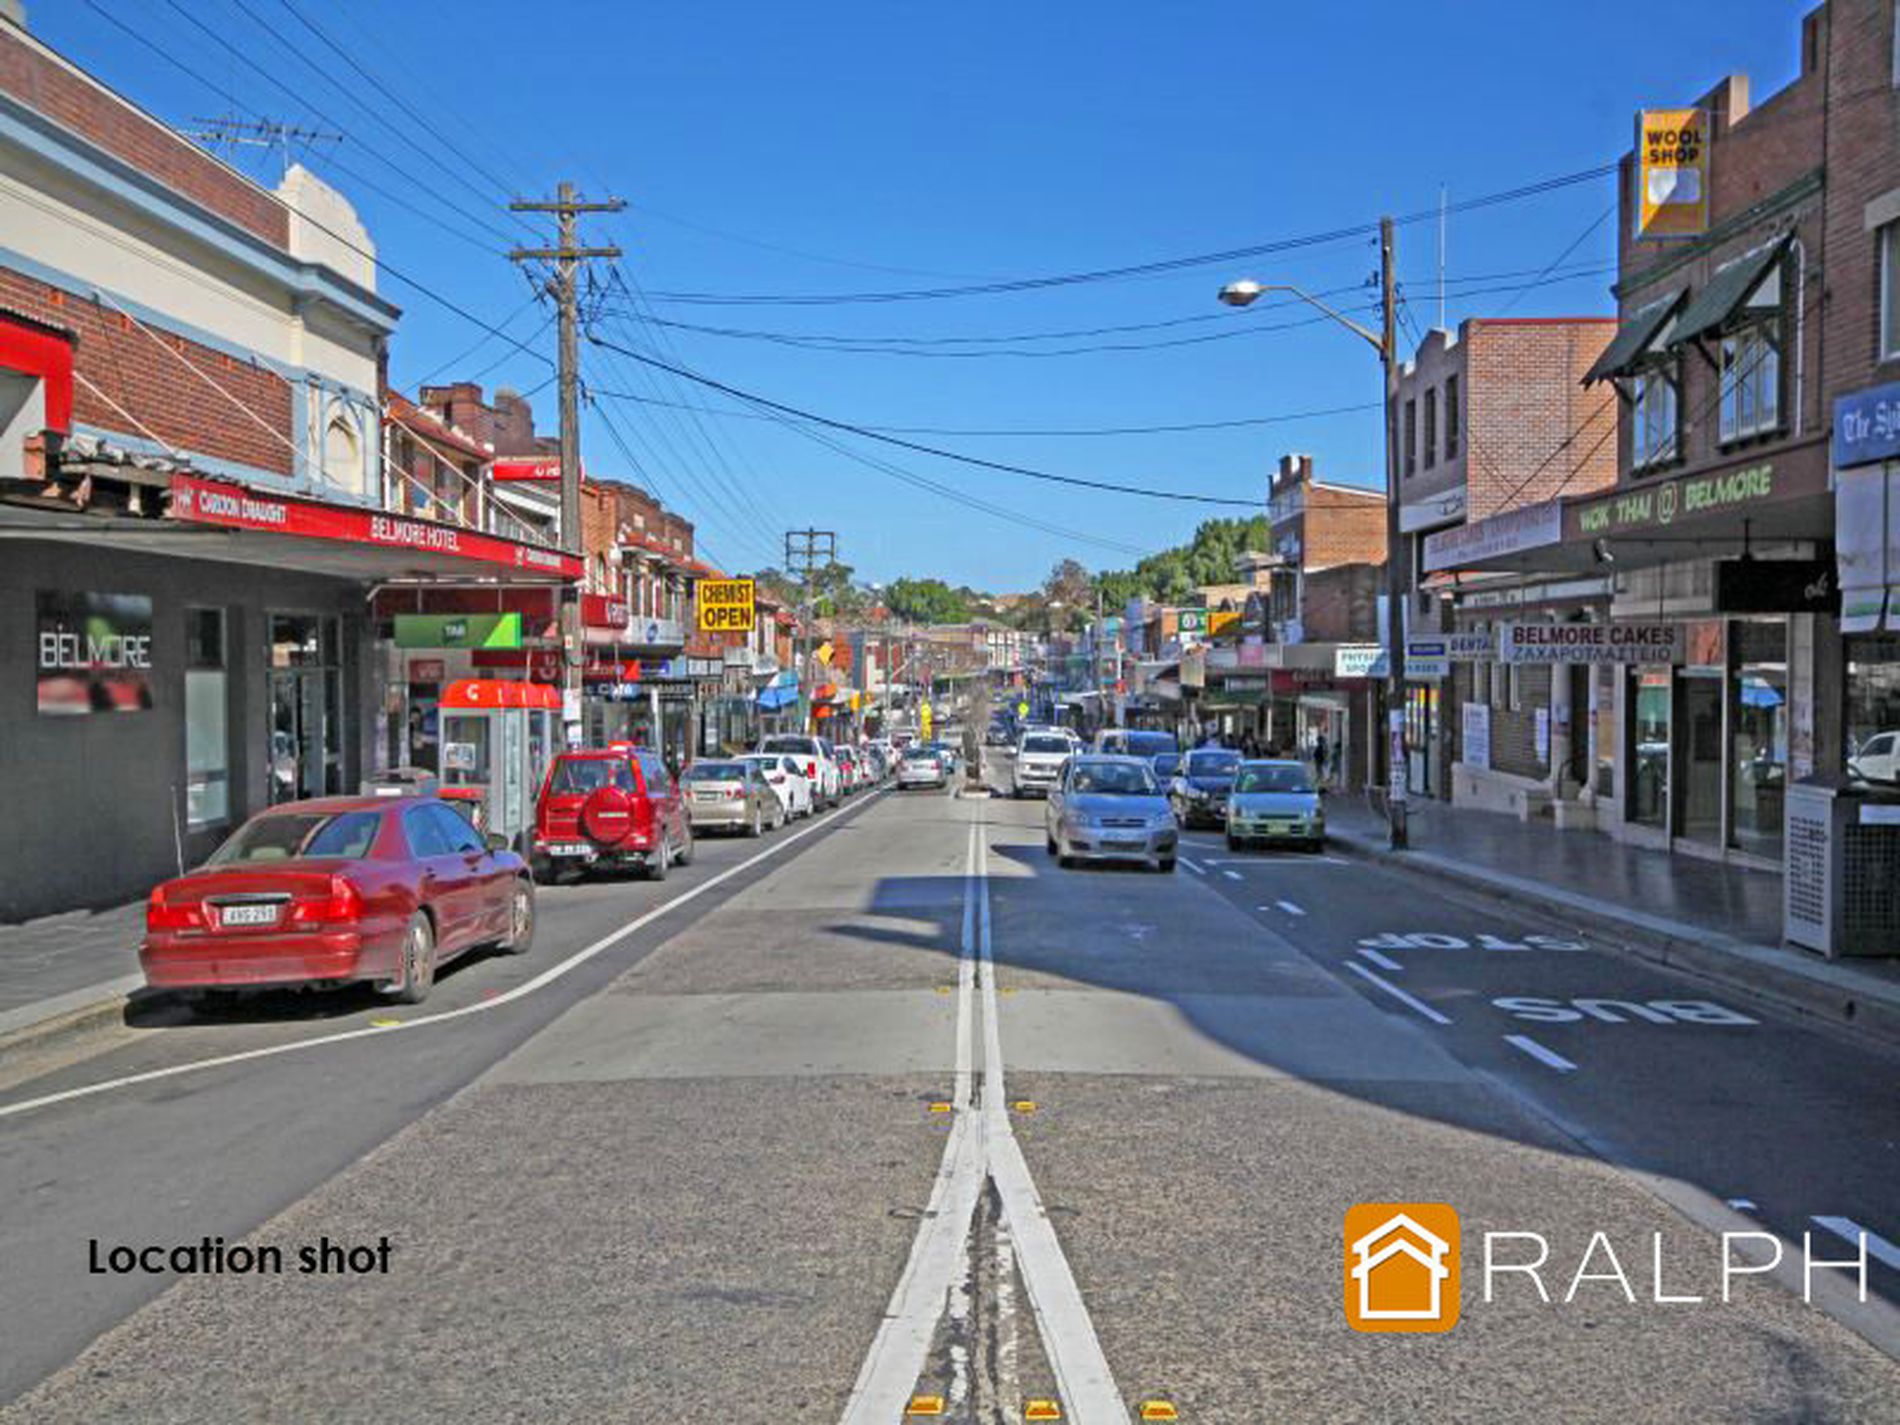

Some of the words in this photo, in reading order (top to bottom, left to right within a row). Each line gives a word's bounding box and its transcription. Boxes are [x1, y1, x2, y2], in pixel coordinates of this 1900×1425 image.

[1647, 130, 1702, 146] WOOL
[1649, 147, 1699, 164] SHOP
[1579, 504, 1609, 532] WOK
[1616, 493, 1652, 523] THAI
[1657, 480, 1678, 525] @
[1684, 464, 1773, 512] BELMORE
[371, 515, 426, 545] BELMORE
[426, 526, 460, 551] HOTEL
[702, 583, 750, 604] CHEMIST
[704, 607, 750, 627] OPEN
[1513, 626, 1604, 645] BELMORE
[1610, 626, 1675, 645] CAKES
[39, 632, 152, 668] BELMORE
[1357, 932, 1588, 951] STOP
[1491, 997, 1760, 1024] BUS
